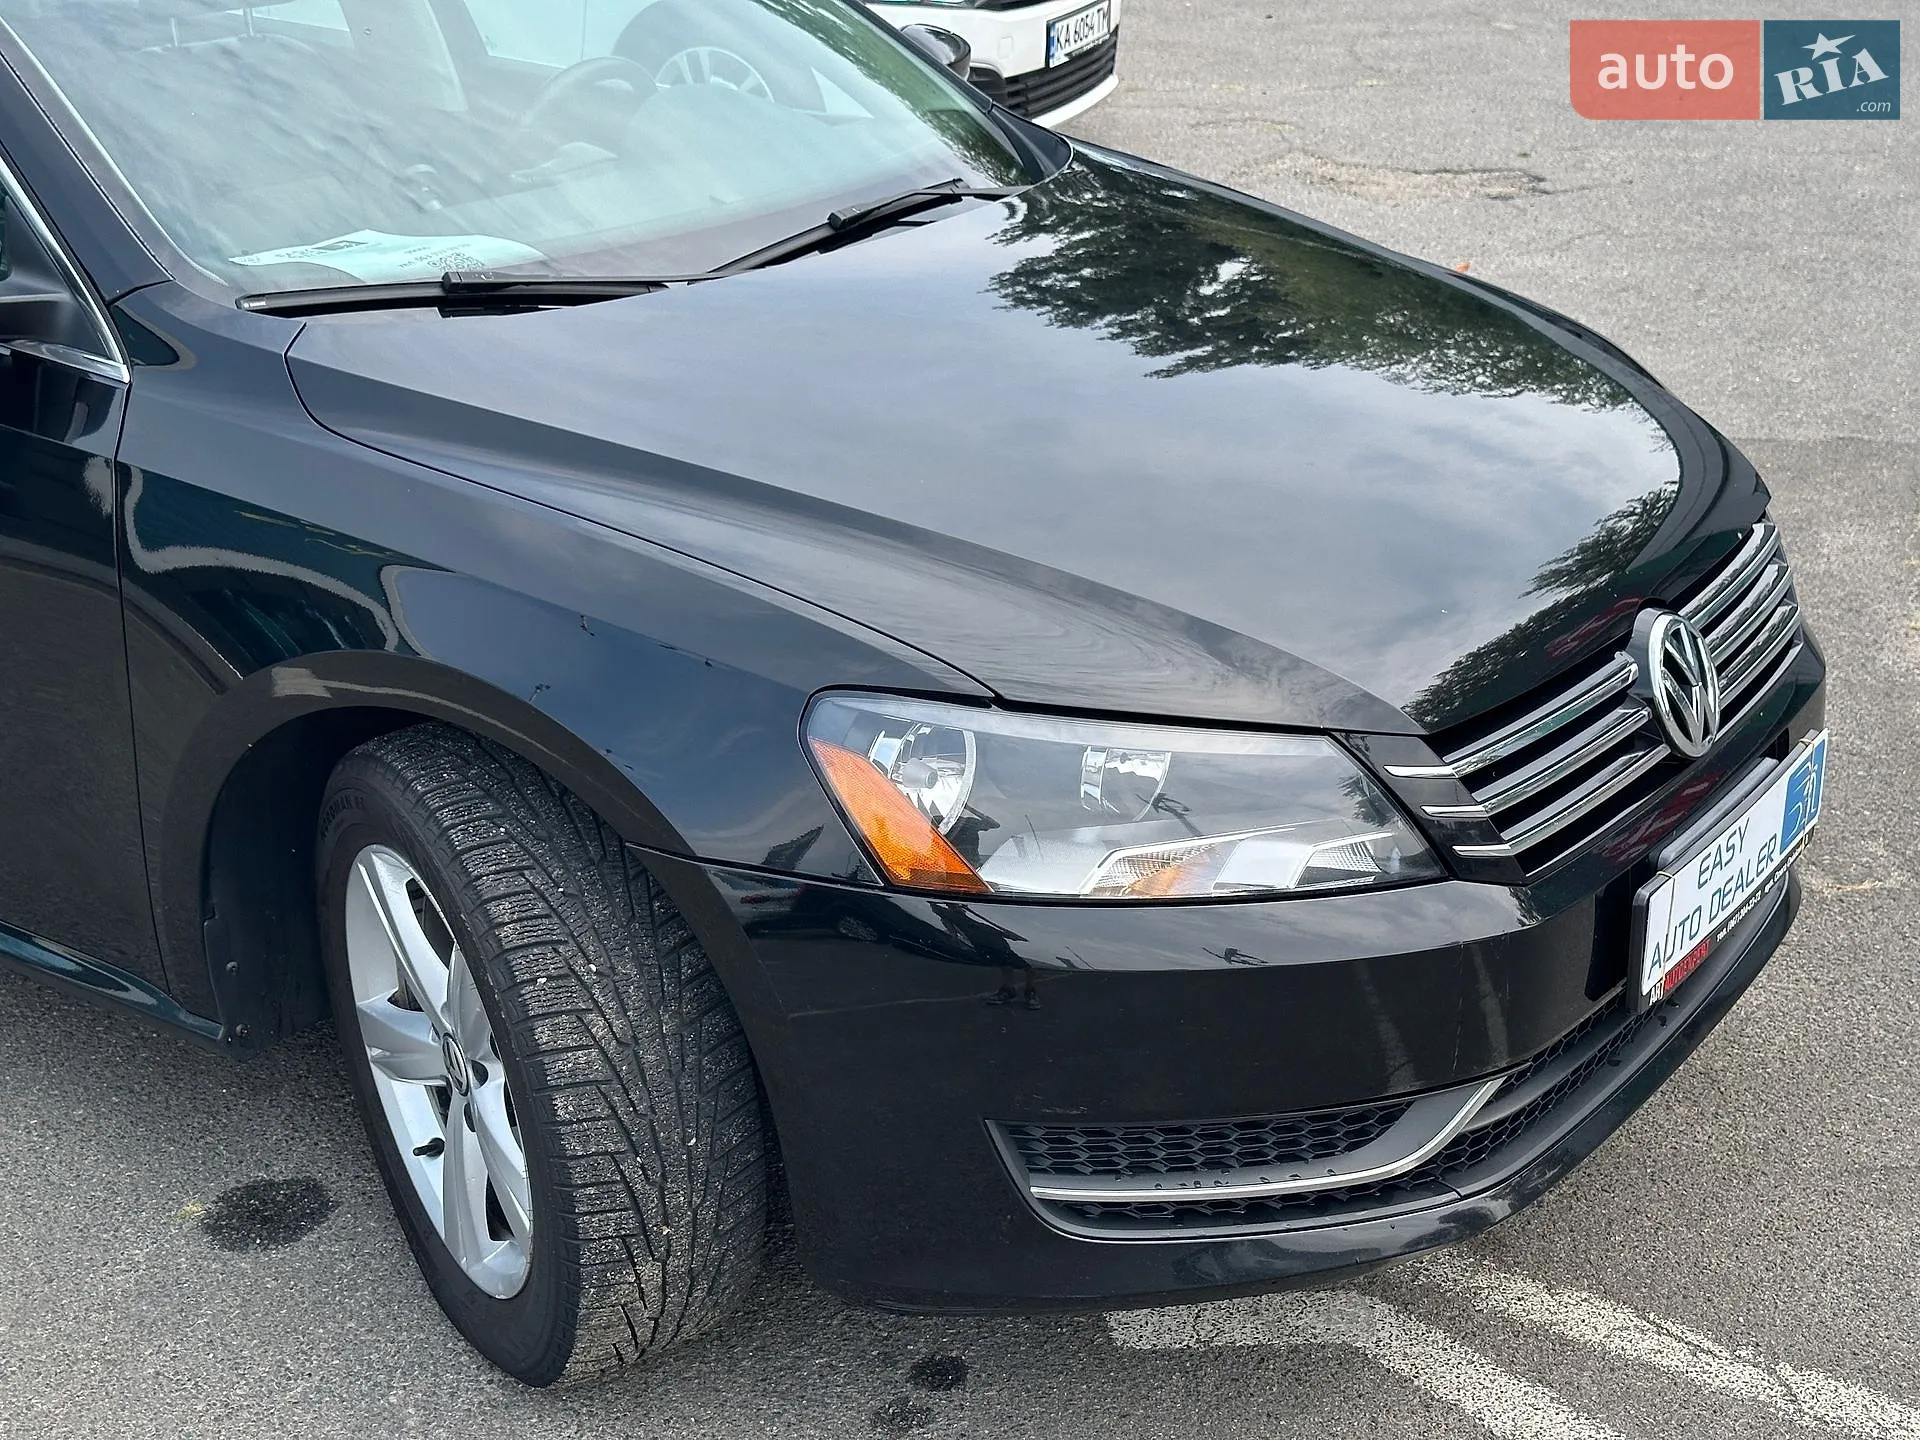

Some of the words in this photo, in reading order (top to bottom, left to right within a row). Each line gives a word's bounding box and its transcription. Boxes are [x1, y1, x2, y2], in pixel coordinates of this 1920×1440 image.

[1647, 904, 1702, 980] AUTO
[1708, 833, 1777, 925] DEALER
[1697, 816, 1750, 890] EASY
